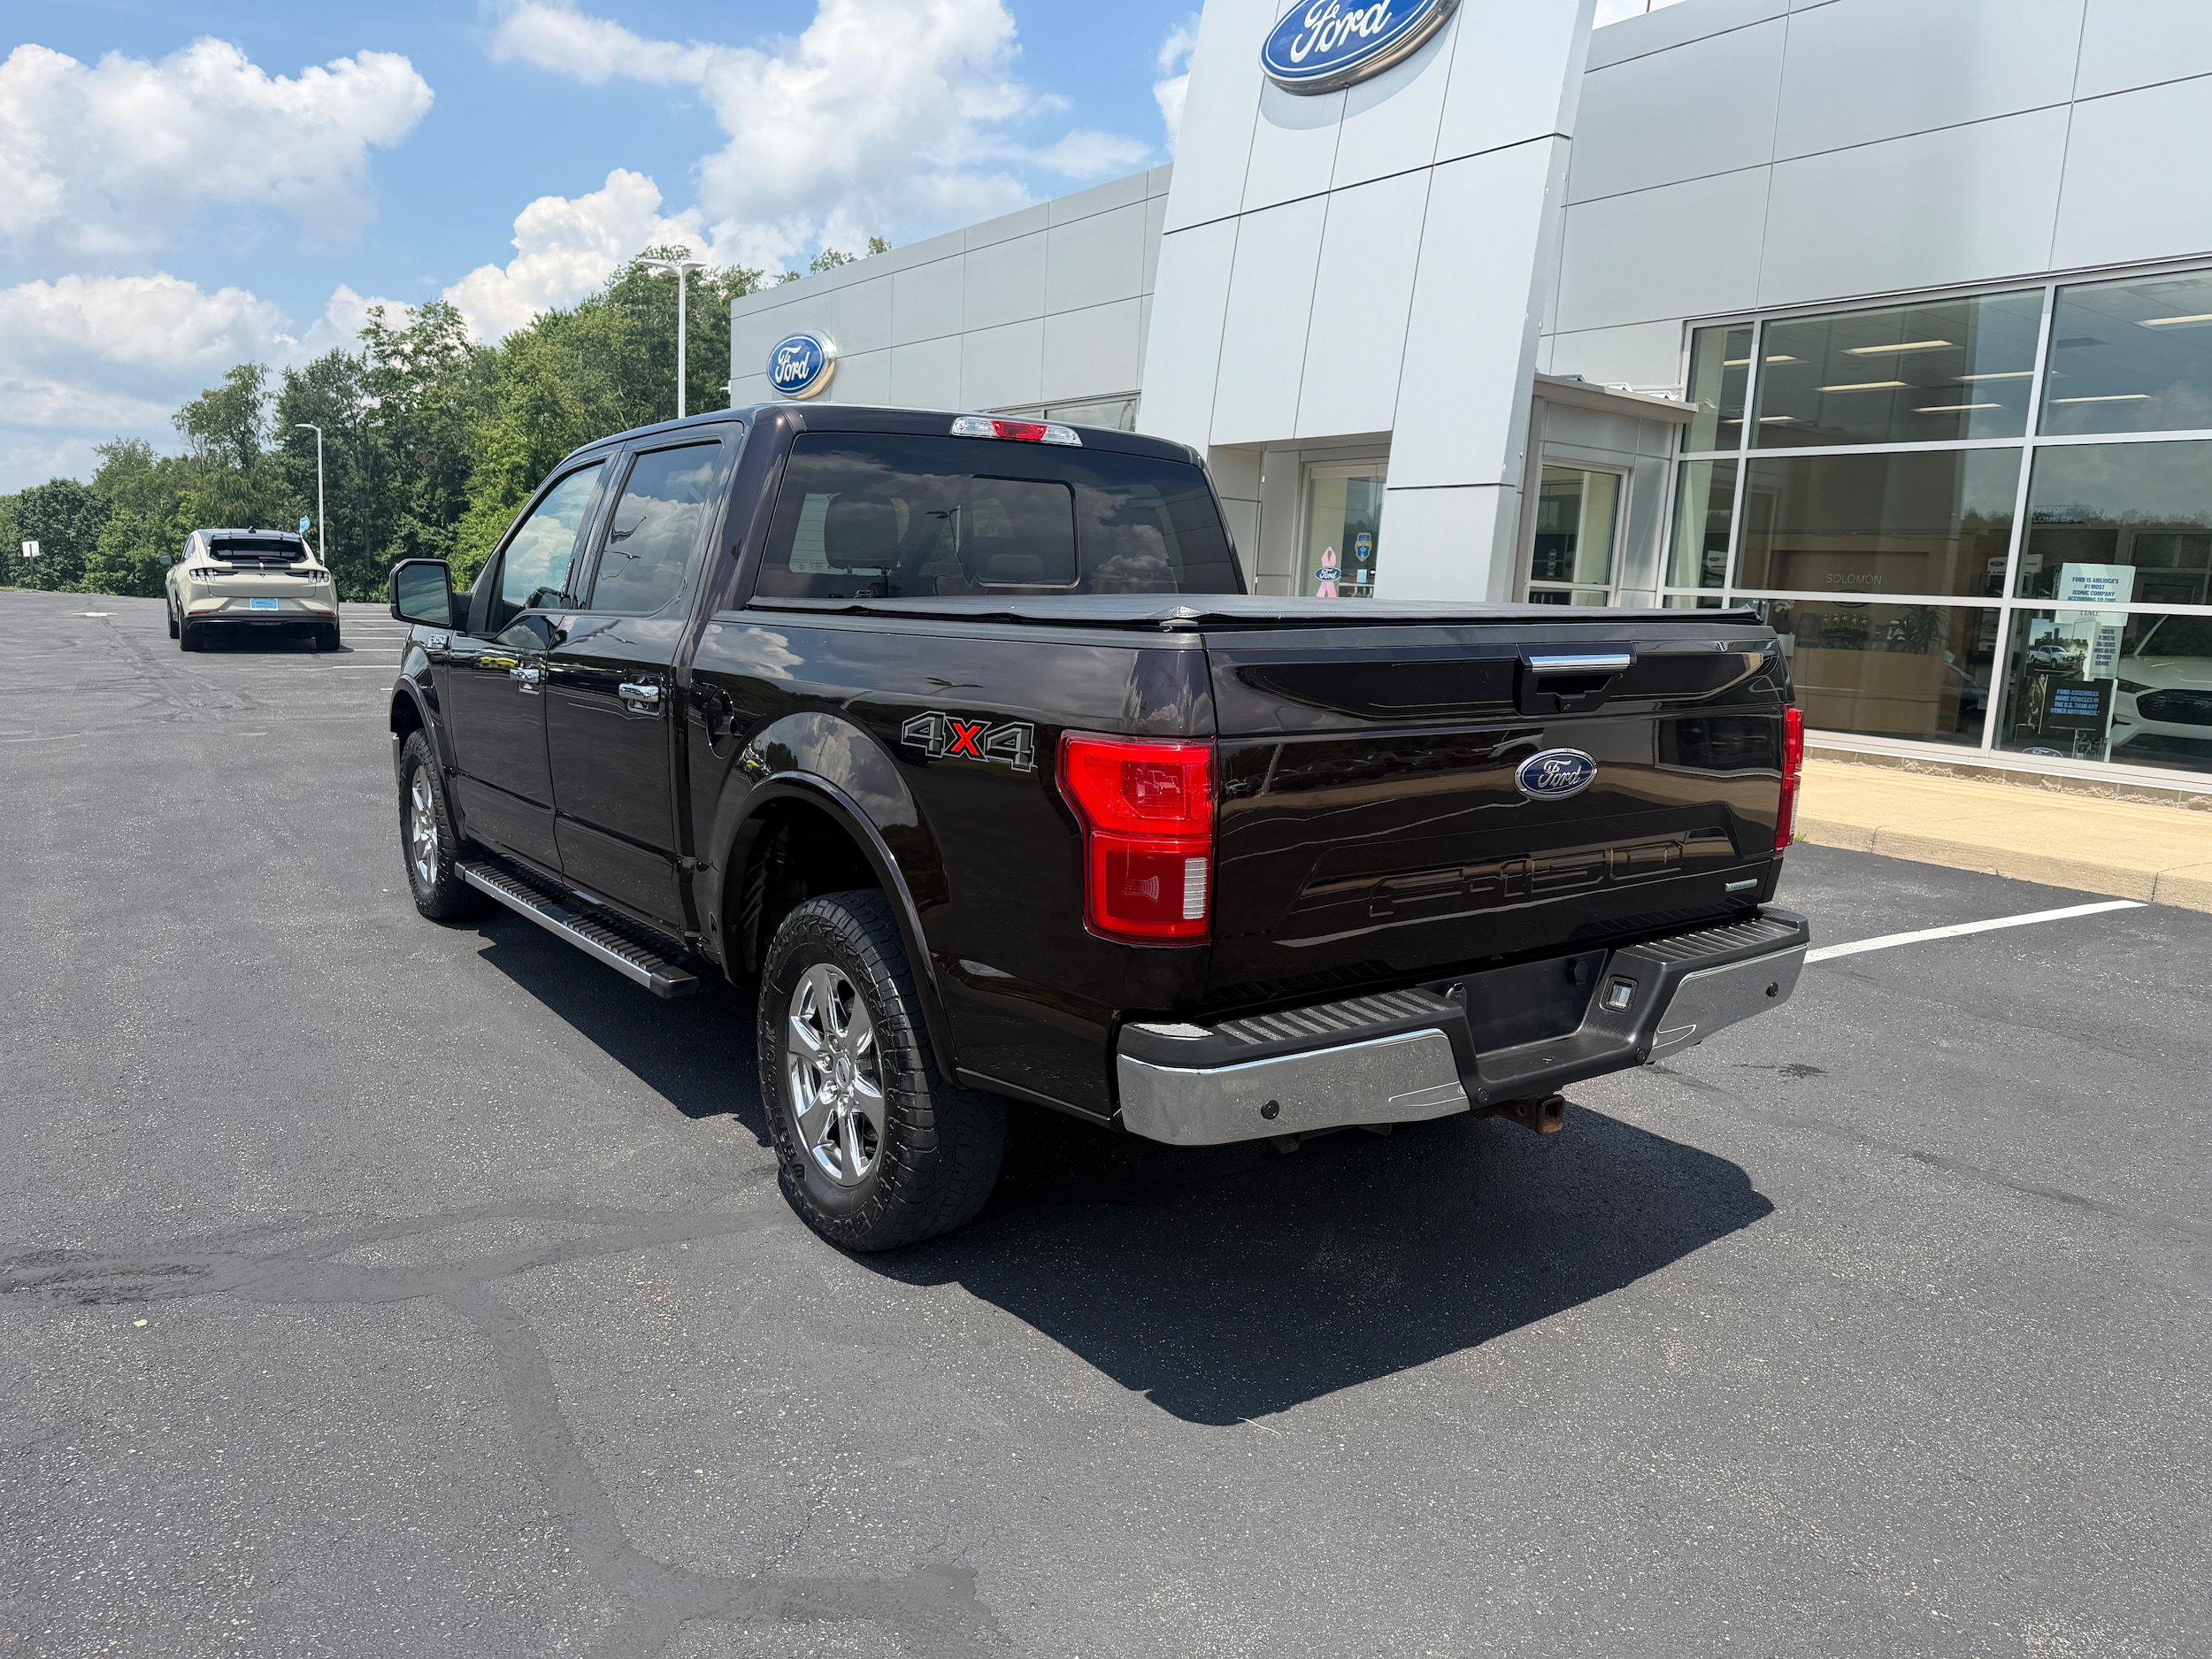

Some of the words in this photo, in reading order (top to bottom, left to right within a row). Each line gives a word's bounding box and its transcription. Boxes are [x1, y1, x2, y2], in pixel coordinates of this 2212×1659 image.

[1290, 0, 1392, 63] Ford
[774, 345, 810, 384] Ford
[1318, 568, 1339, 580] Ford
[1825, 572, 1882, 584] SOLOMON
[1537, 760, 1582, 788] Ford
